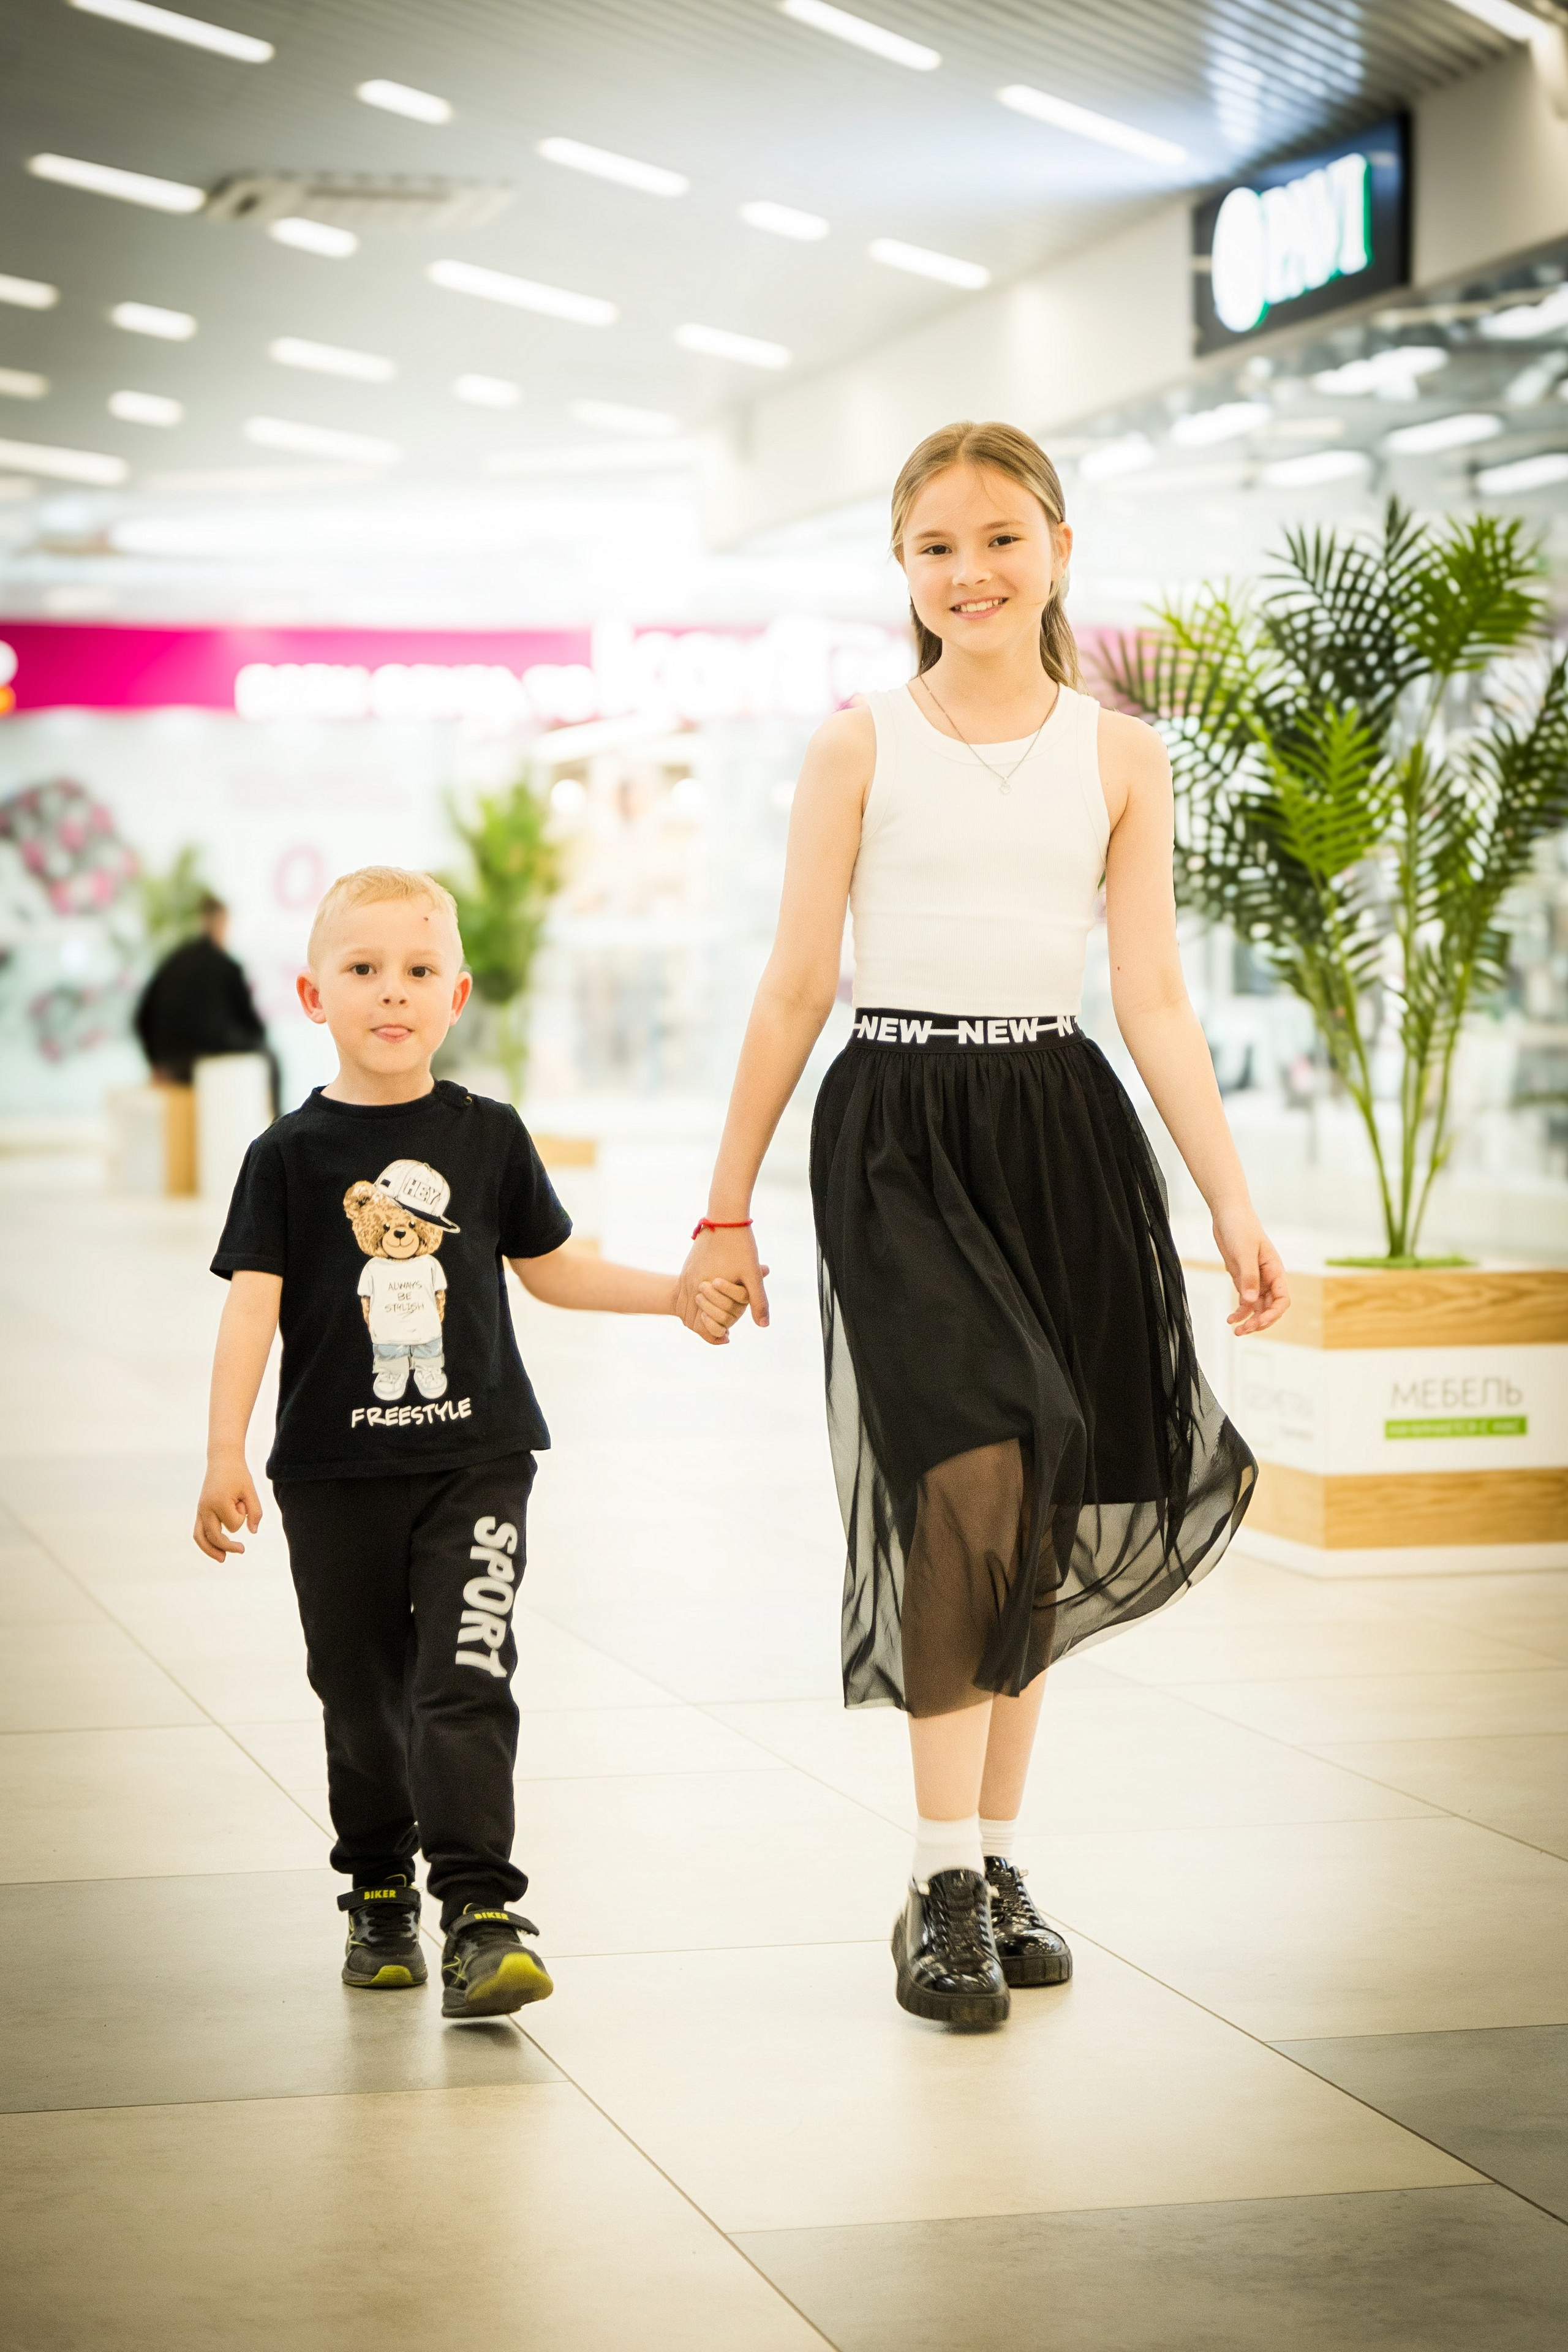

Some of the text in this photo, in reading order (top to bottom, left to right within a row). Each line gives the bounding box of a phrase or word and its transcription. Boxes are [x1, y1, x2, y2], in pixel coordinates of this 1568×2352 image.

[402, 1177, 441, 1205] HEY
[388, 1281, 422, 1291] ALWAYS
[398, 1291, 412, 1301] BE
[385, 1302, 424, 1312] STYLISH
[1391, 1377, 1523, 1409] МЕБЕЛЬ
[351, 1398, 472, 1428] FREESTYLE
[364, 1890, 396, 1900] BIKER
[473, 1912, 509, 1921] BIKER
